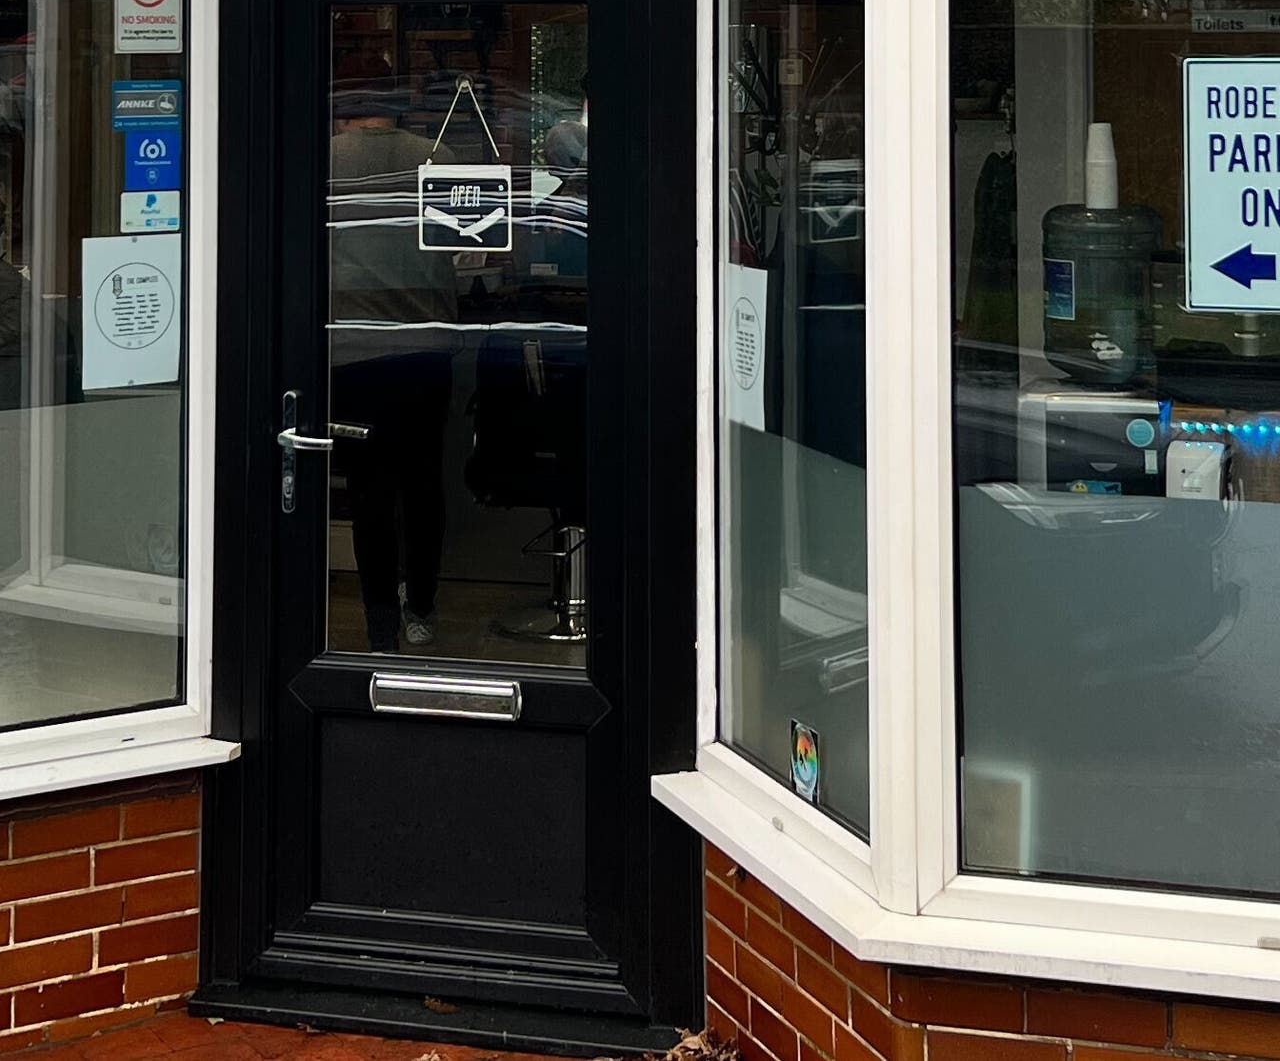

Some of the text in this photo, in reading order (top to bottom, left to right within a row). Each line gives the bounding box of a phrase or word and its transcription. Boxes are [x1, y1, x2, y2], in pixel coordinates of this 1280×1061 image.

[121, 15, 135, 24] NO
[1194, 18, 1244, 31] Toilets
[116, 99, 156, 109] ANNKE
[450, 185, 481, 207] OPEN
